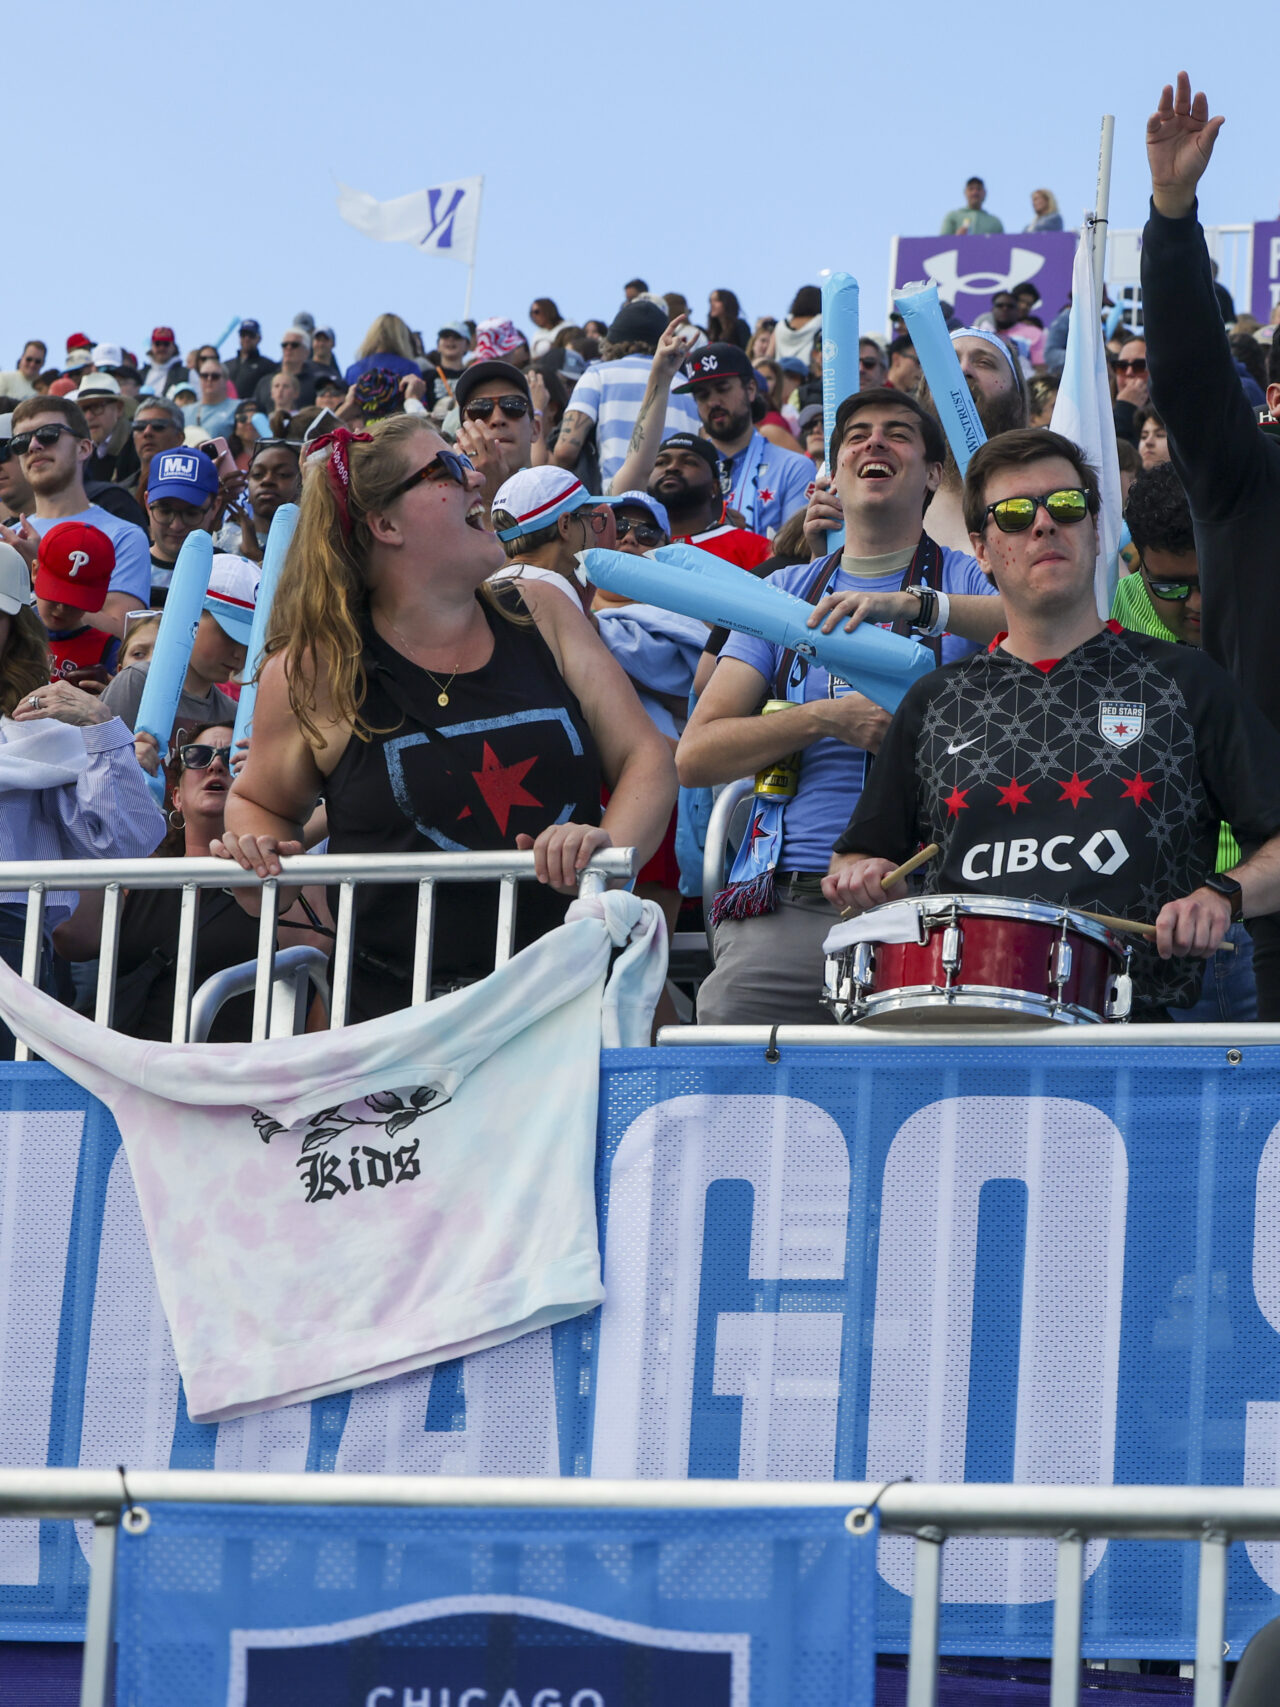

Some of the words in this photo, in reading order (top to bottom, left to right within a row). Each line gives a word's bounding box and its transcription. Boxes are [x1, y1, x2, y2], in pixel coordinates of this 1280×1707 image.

[950, 390, 982, 454] WINTRUST
[164, 457, 194, 473] MJ
[68, 550, 90, 577] P
[1102, 706, 1117, 715] RED
[1119, 707, 1143, 717] STARS
[961, 834, 1076, 881] CIBC
[296, 1138, 421, 1203] Kids
